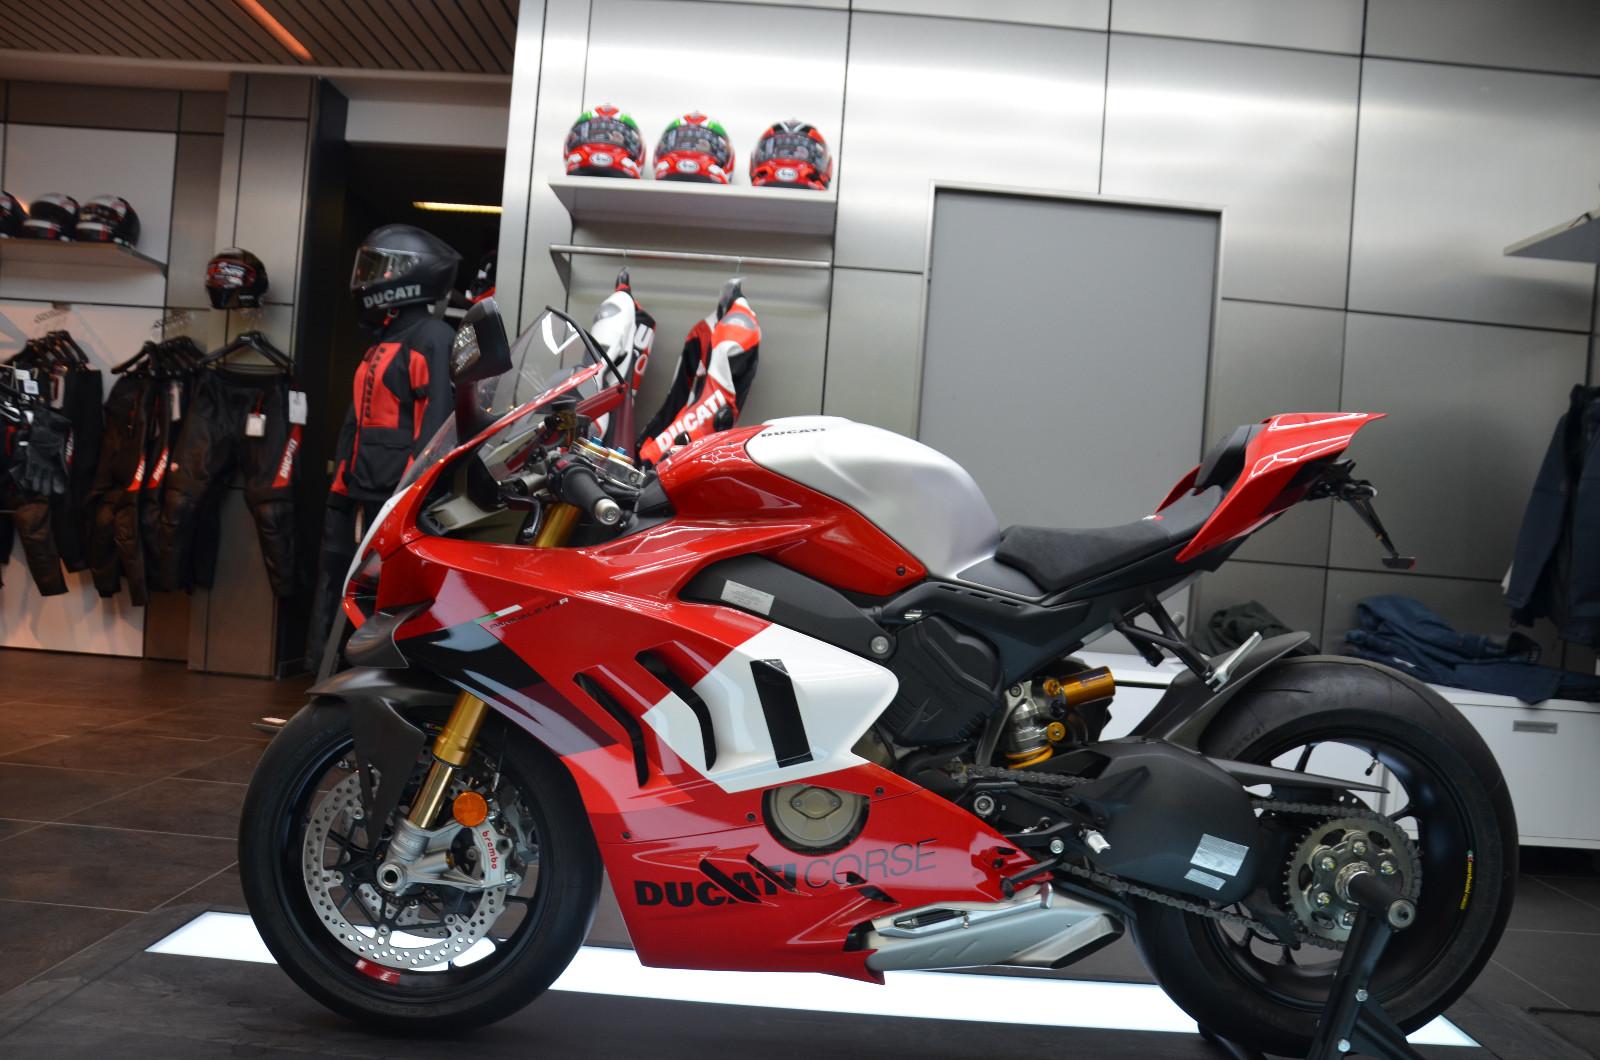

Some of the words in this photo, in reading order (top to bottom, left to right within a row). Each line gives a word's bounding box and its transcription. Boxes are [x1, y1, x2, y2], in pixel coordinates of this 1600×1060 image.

[363, 284, 421, 308] DUCATI
[365, 347, 386, 418] DUCATI
[656, 390, 727, 453] DUCATI
[761, 427, 826, 437] DUCATI
[280, 438, 298, 479] DUCATI
[482, 830, 499, 869] brembo
[804, 838, 938, 889] CORSE
